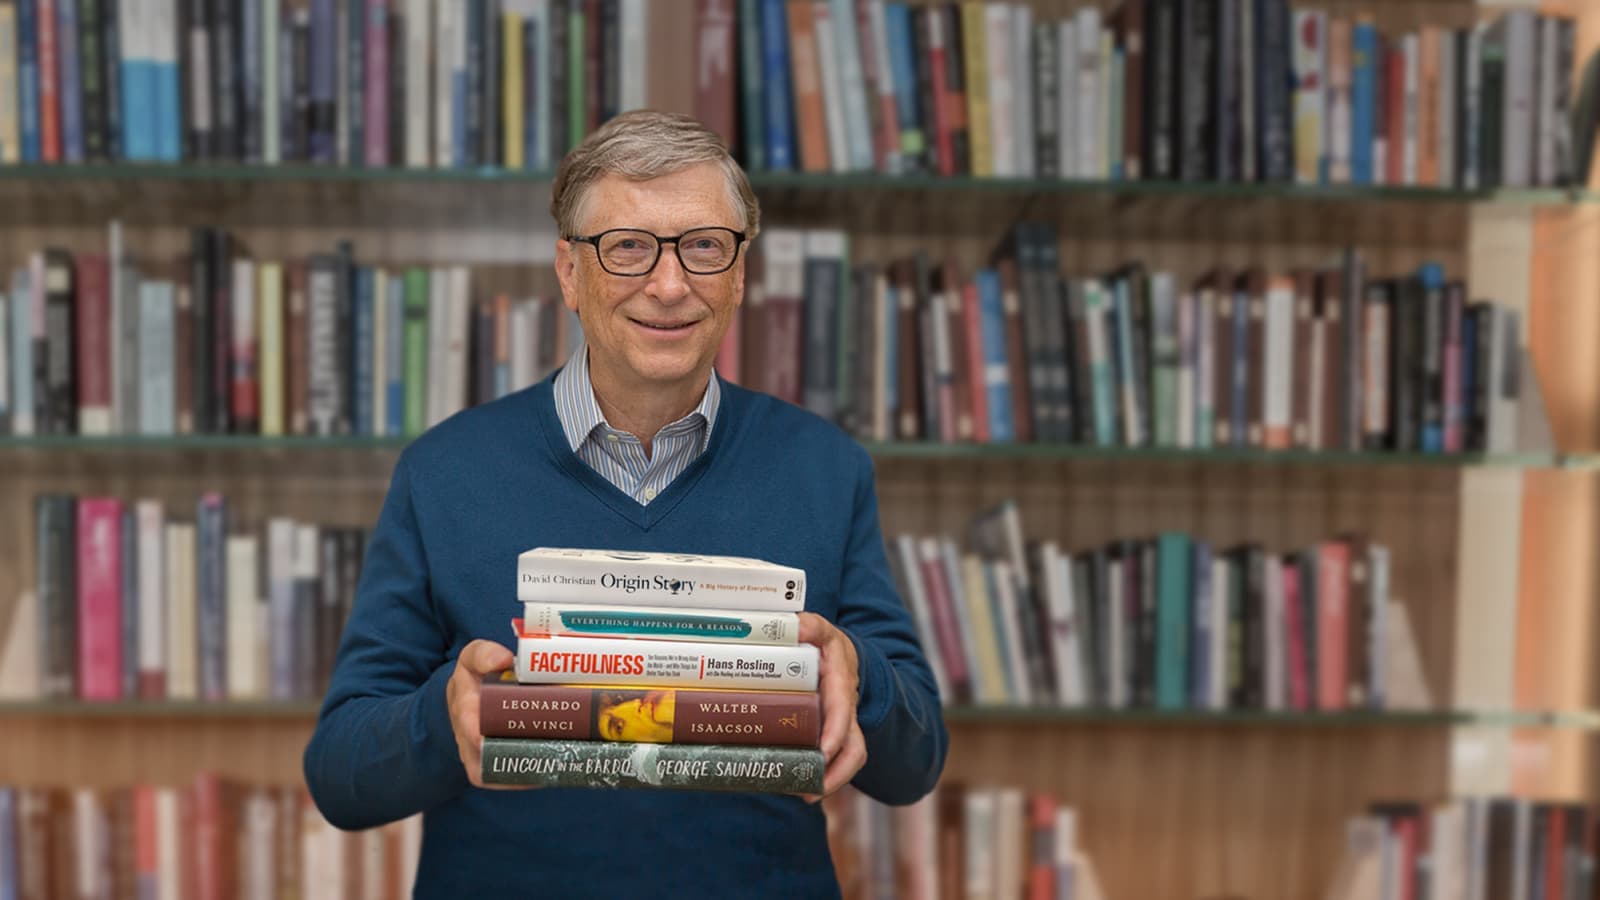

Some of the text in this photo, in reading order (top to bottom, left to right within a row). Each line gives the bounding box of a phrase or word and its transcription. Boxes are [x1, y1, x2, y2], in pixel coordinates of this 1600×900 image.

[522, 573, 550, 584] David
[553, 574, 596, 585] Christian
[601, 573, 650, 593] Origin
[653, 575, 696, 595] Story
[571, 617, 630, 626] EVERYTHING
[633, 620, 673, 628] HAPPENS
[707, 623, 742, 632] REASON
[530, 651, 644, 676] FACTFULNESS
[708, 658, 733, 670] Hans
[736, 659, 775, 673] Rosling
[502, 700, 581, 711] LEONARDO
[700, 703, 759, 713] WALTER
[508, 720, 574, 730] DA VINCI
[691, 723, 764, 734] ISAACSON
[493, 757, 556, 774] LINCOLN
[556, 761, 567, 772] IN
[586, 758, 635, 776] BARDO
[656, 759, 784, 779] GEORGE SAUNDERS
